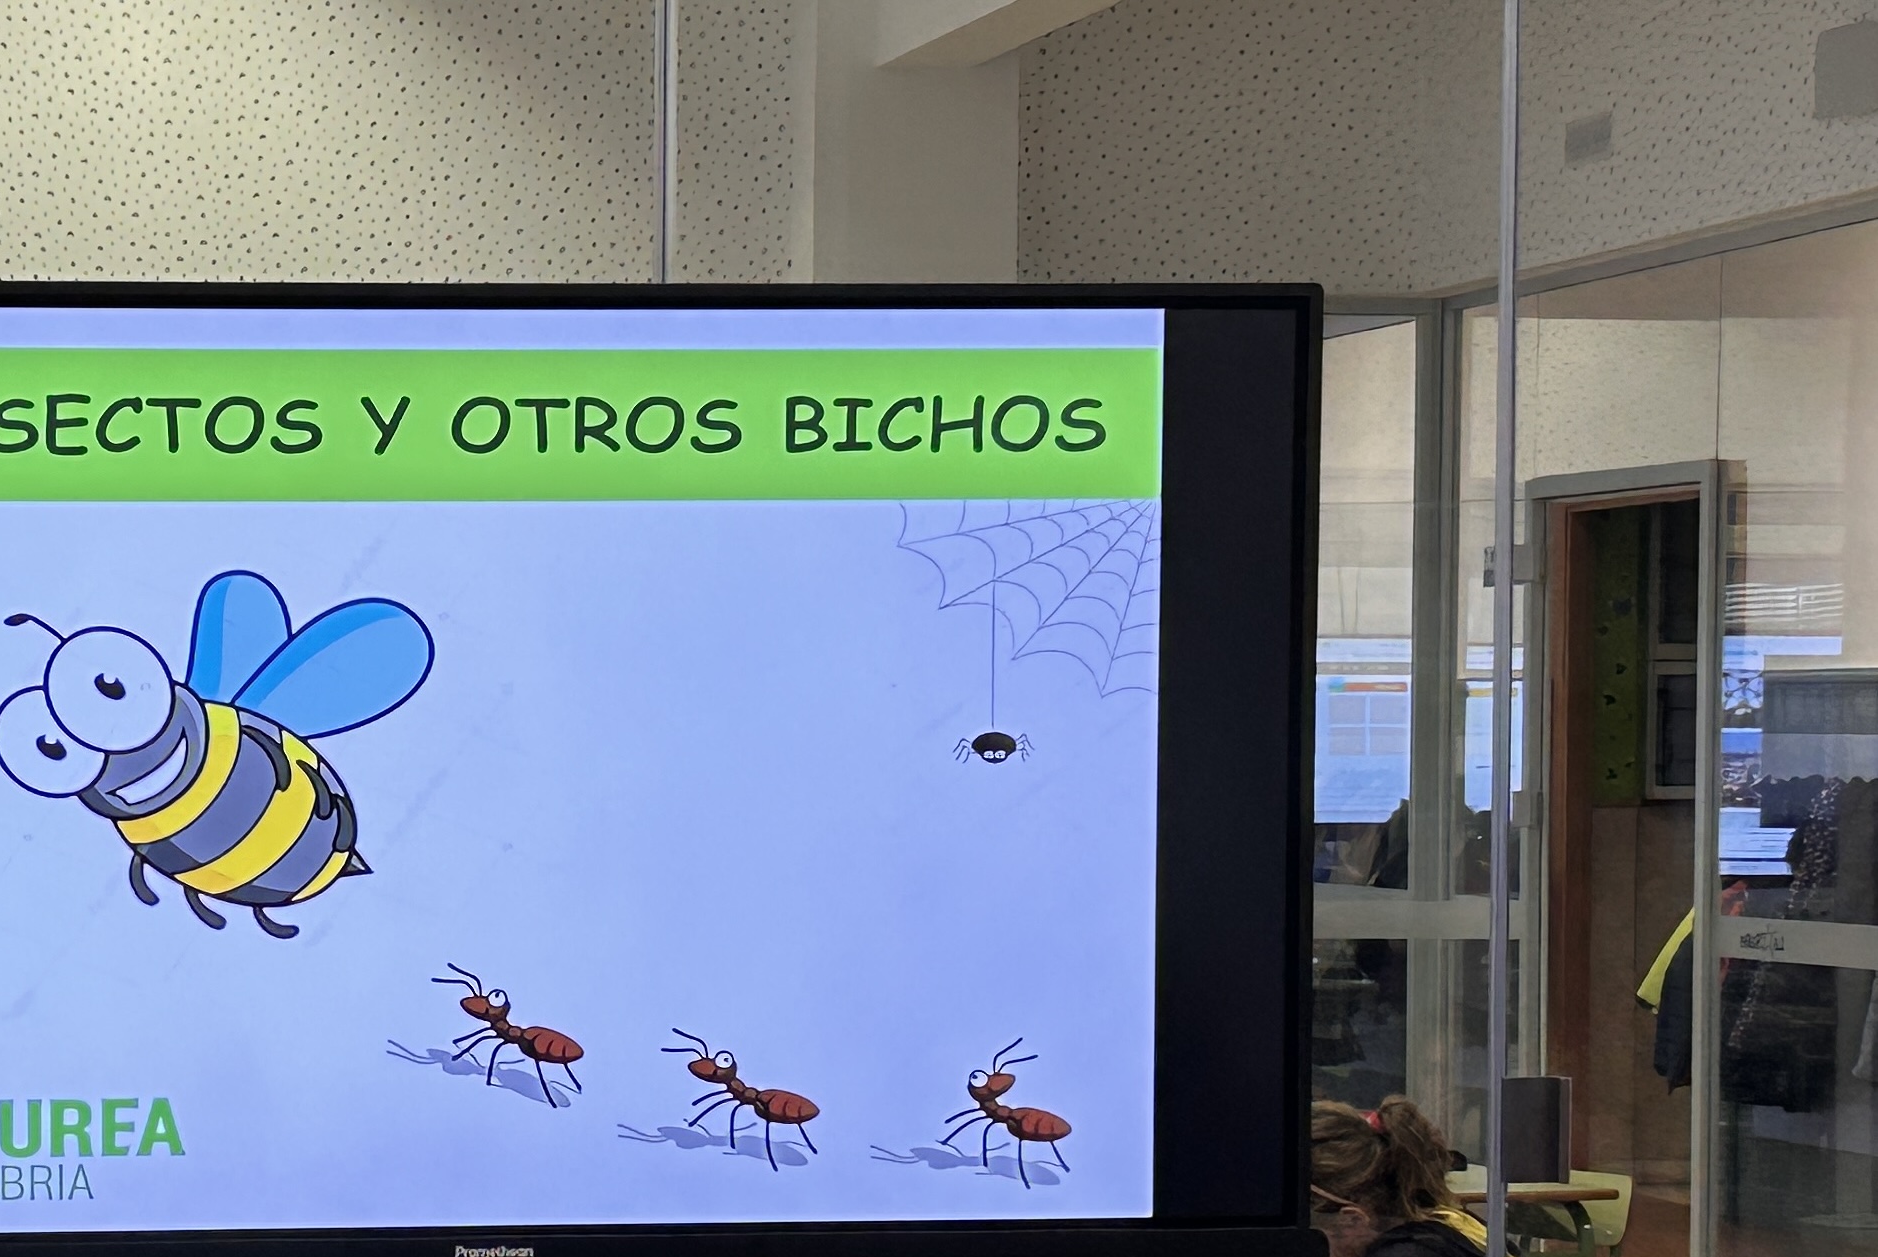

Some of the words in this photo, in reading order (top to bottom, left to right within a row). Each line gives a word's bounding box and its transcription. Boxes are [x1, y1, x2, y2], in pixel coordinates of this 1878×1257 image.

[359, 394, 412, 457] Y
[450, 395, 743, 455] OTROS
[784, 394, 1108, 455] BICHOS
